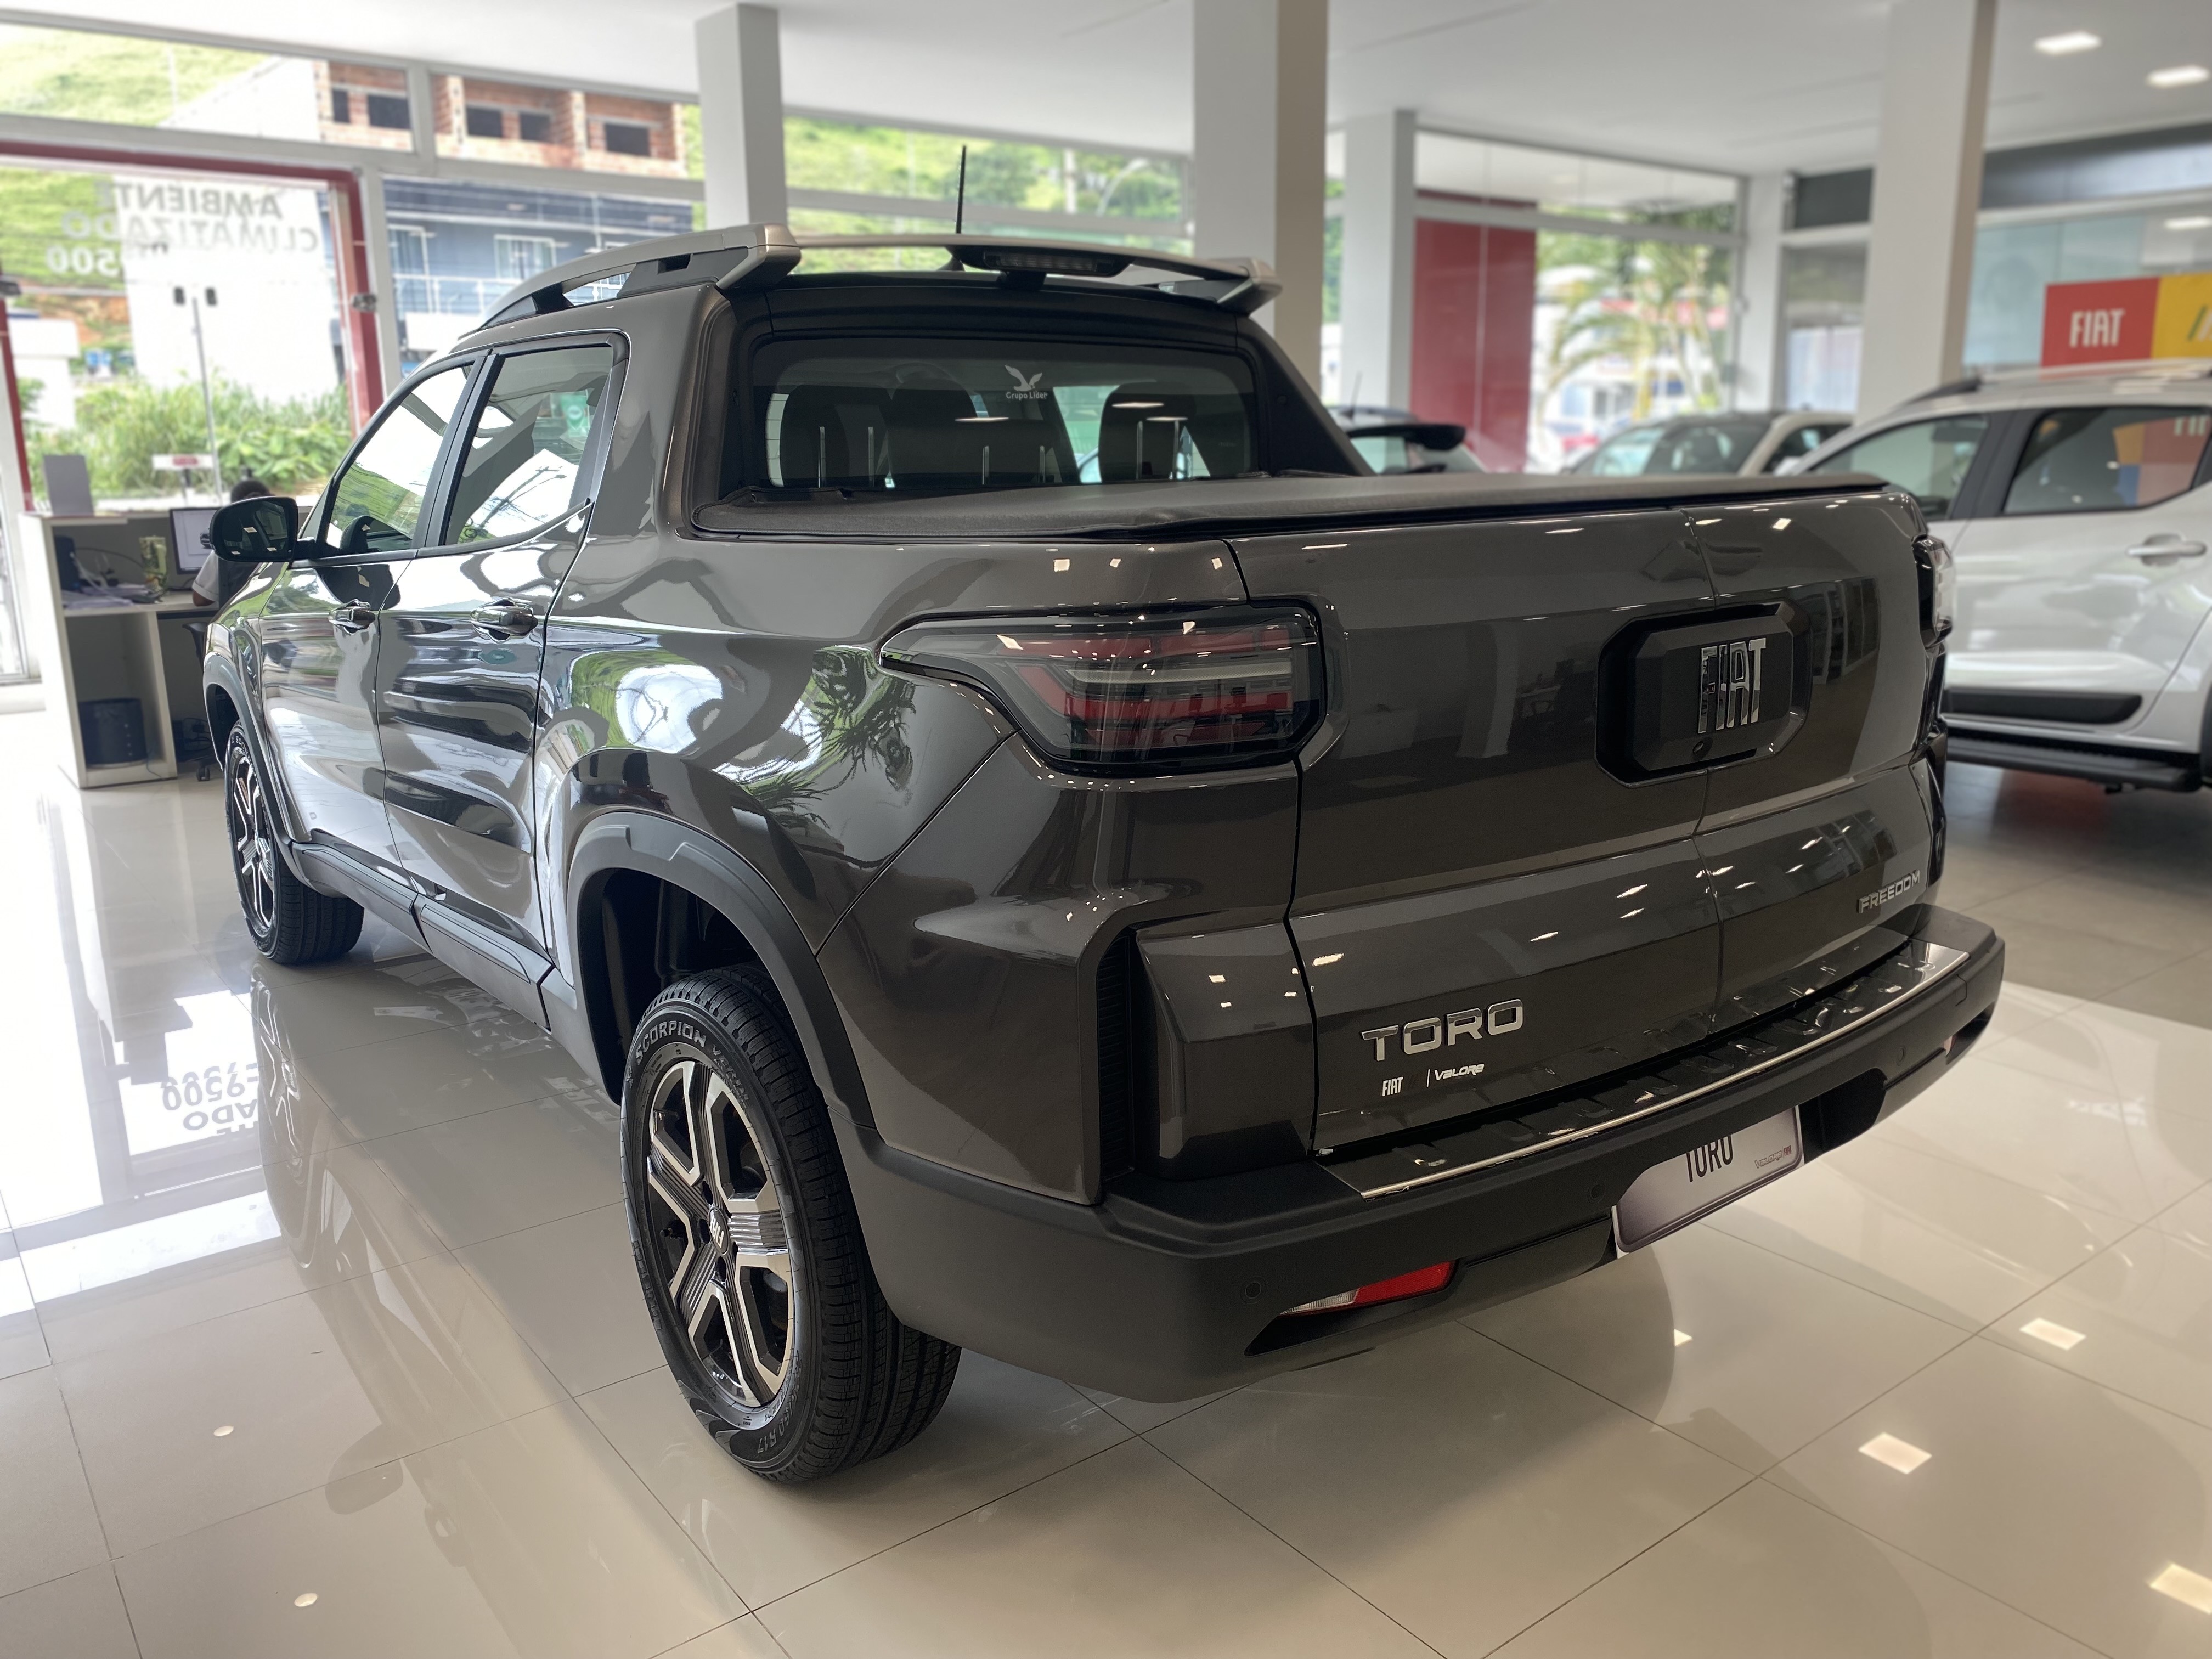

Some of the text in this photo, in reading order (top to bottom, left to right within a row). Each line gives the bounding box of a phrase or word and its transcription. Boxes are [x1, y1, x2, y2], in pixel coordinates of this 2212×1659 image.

[2069, 307, 2126, 347] FIAT
[1006, 392, 1028, 400] Grupo
[1697, 637, 1767, 734] FIAT
[1857, 870, 1920, 913] FREEDOM
[636, 1020, 707, 1065] SCORPION
[1360, 998, 1524, 1061] TORO
[1381, 1076, 1404, 1097] FIAT
[757, 1428, 777, 1454] R17
